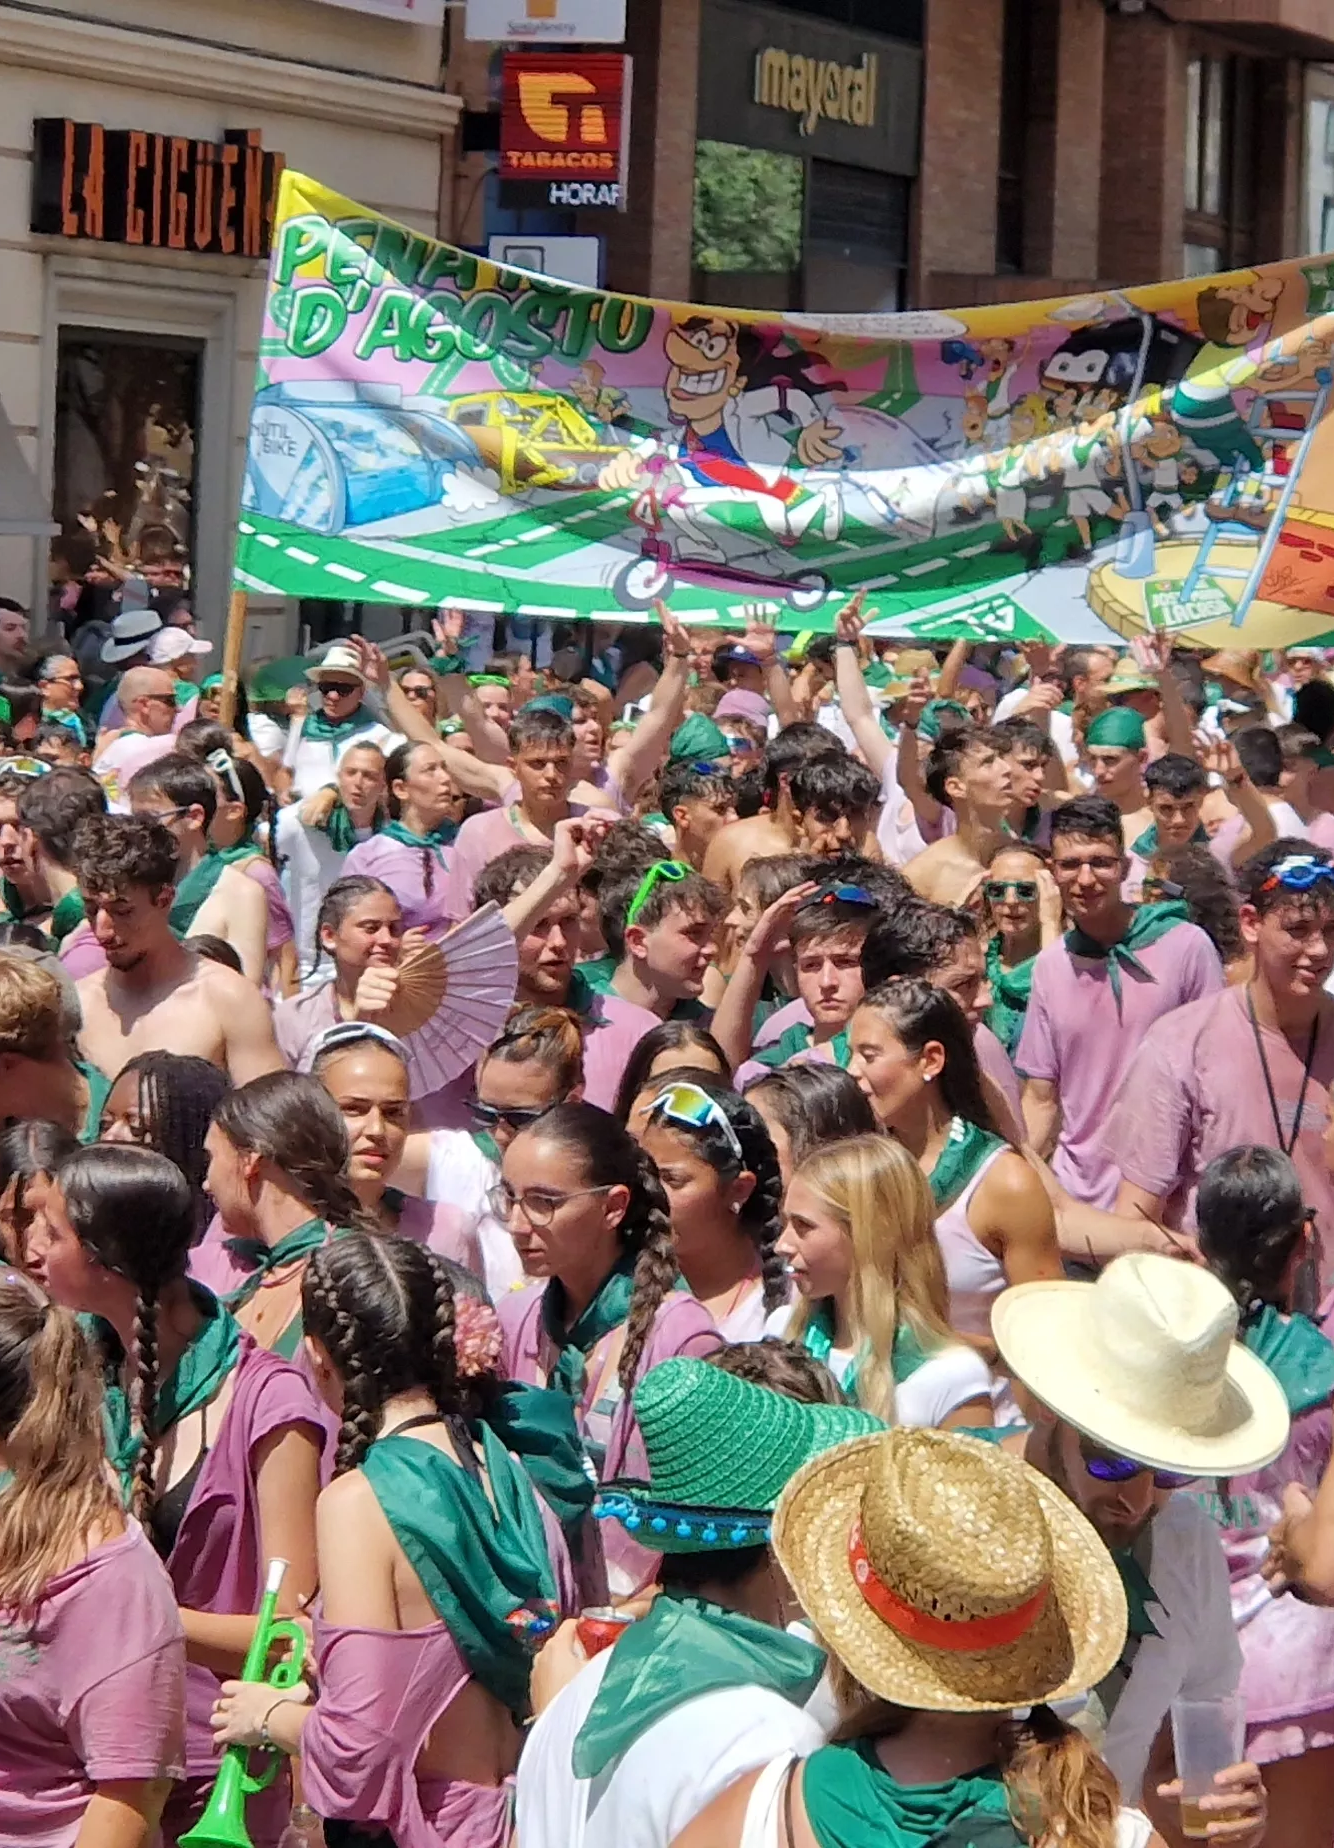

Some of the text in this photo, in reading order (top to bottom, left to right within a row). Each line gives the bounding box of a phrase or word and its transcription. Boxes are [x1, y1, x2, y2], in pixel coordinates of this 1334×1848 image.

[755, 48, 878, 137] mayoral
[62, 118, 104, 240] LA
[506, 150, 614, 169] TABACOS
[262, 438, 298, 458] BIKE
